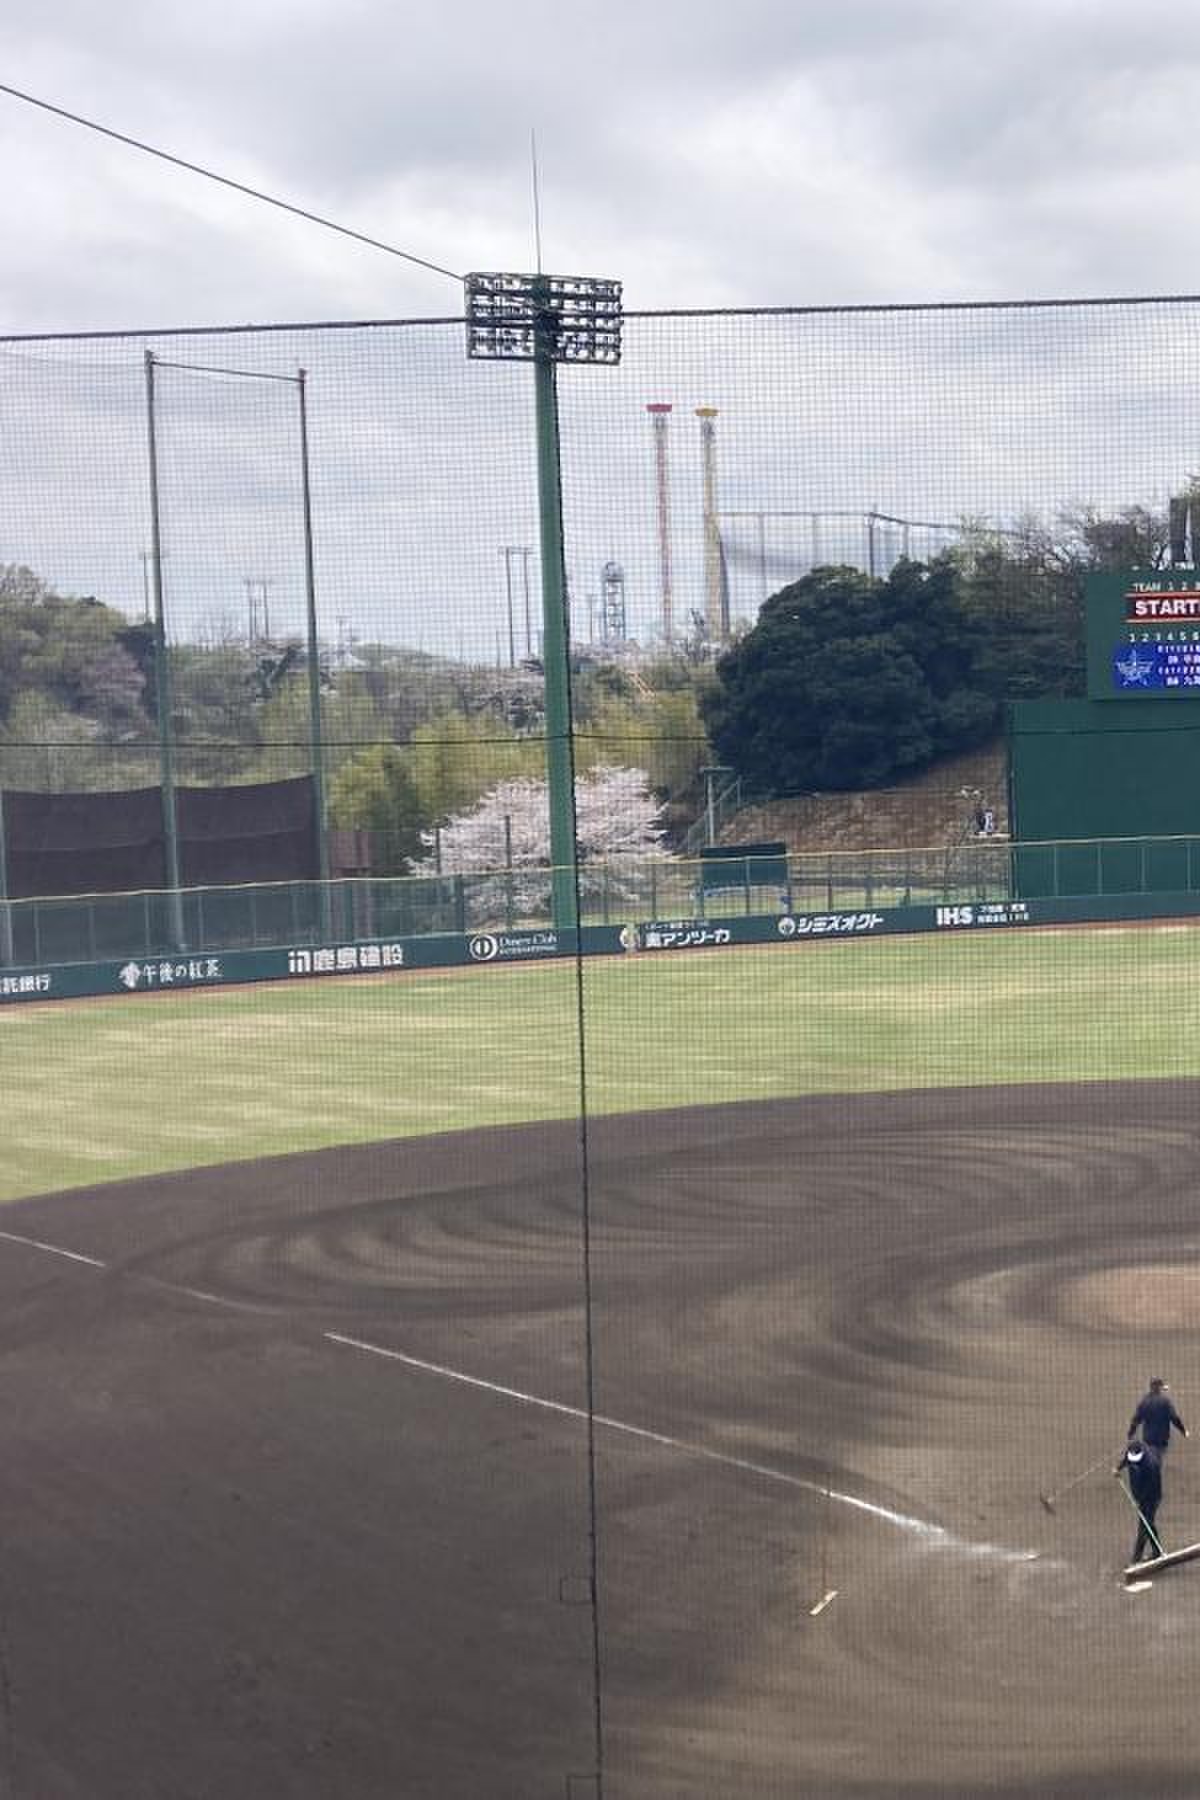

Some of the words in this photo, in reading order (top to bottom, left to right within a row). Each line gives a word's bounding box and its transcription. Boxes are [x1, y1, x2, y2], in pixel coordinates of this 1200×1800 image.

[797, 914, 884, 933] シミズオクト
[936, 906, 974, 926] IHS
[313, 944, 404, 972] 鹿島建設
[143, 959, 224, 984] 午後の紅茶
